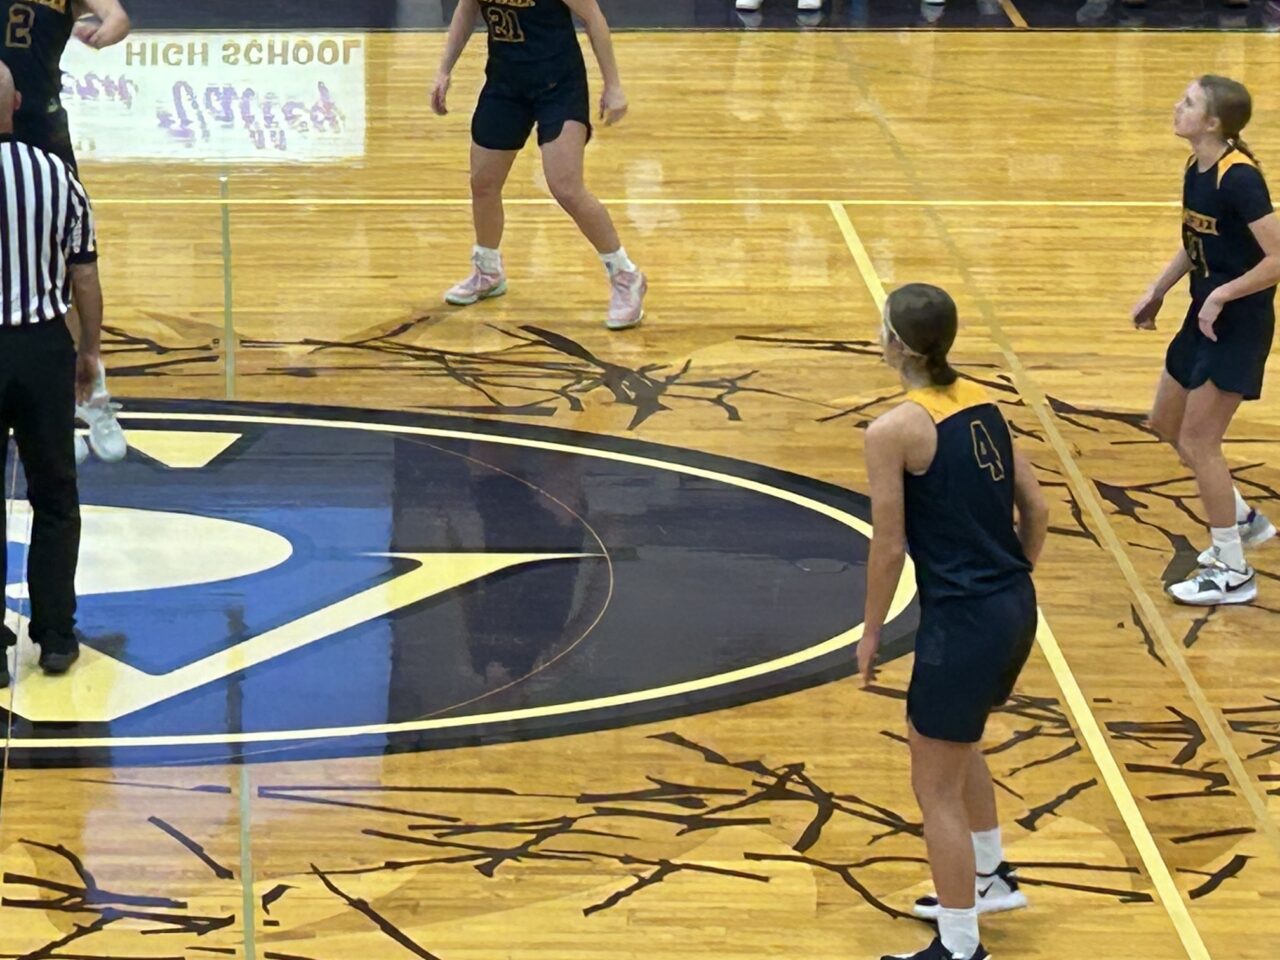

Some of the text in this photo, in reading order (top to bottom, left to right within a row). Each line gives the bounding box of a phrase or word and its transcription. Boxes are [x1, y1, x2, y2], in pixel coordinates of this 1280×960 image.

[4, 2, 36, 49] 2
[487, 7, 524, 42] 21
[970, 419, 1006, 482] 4
